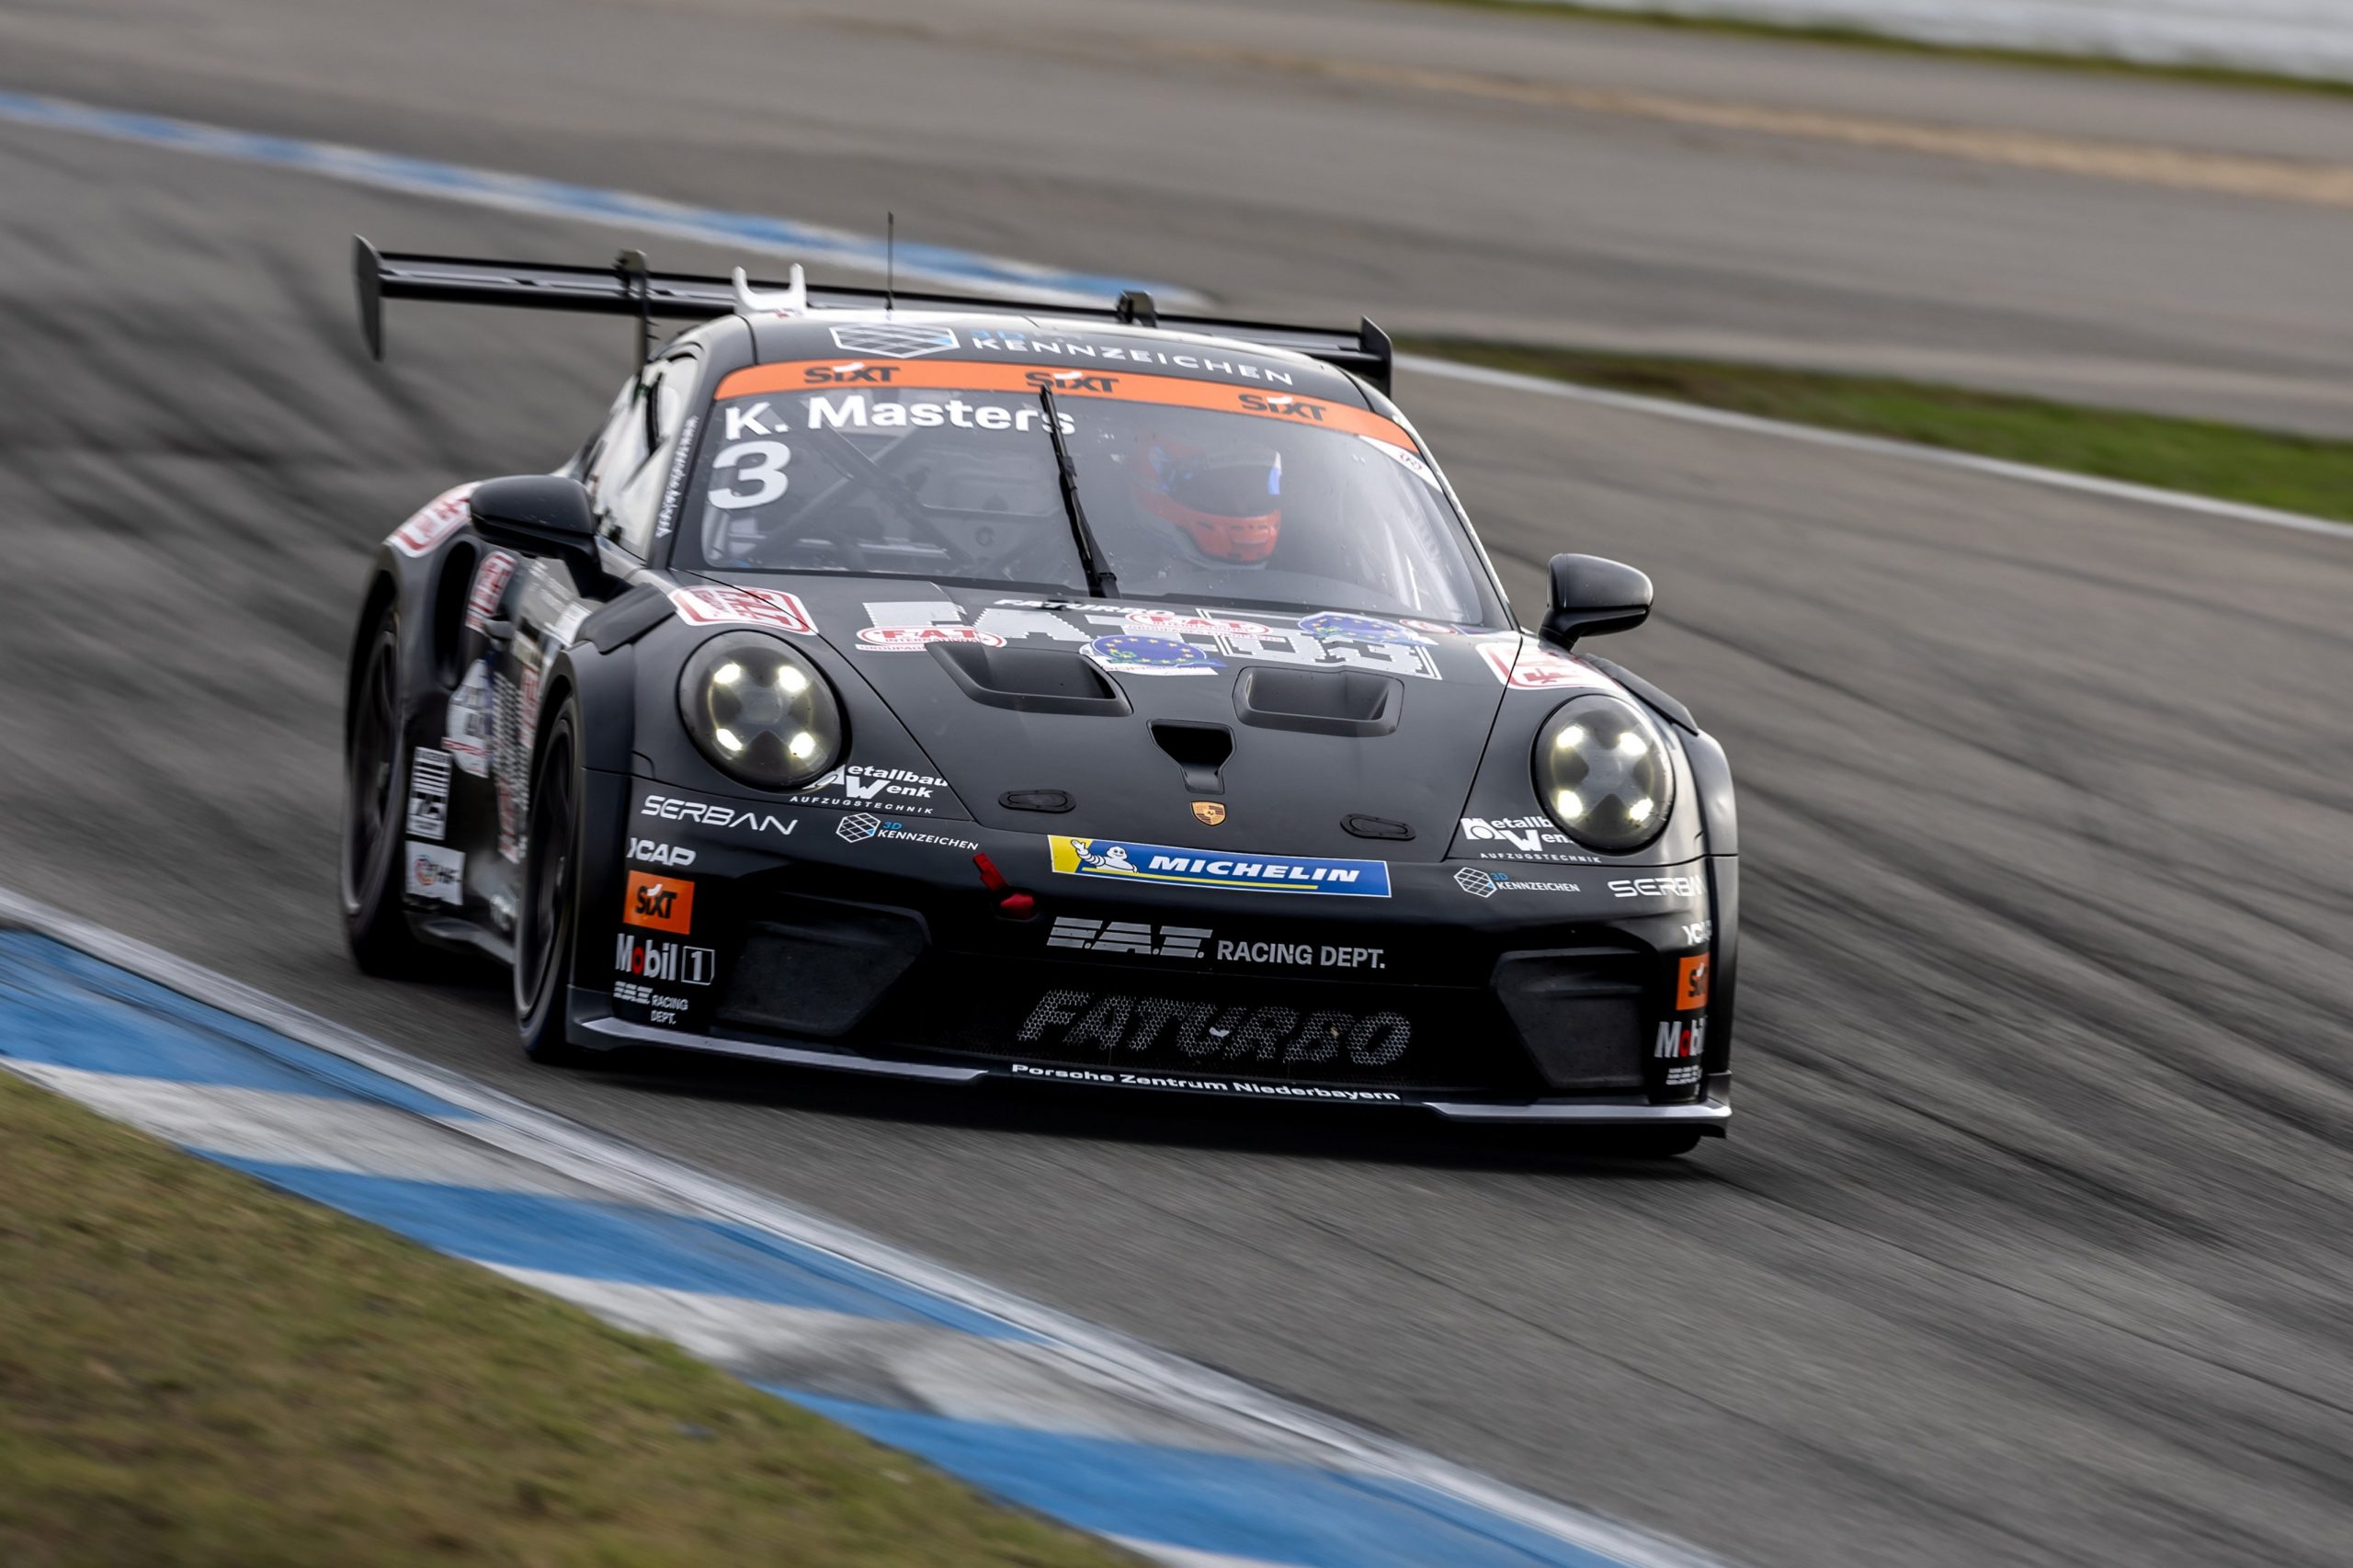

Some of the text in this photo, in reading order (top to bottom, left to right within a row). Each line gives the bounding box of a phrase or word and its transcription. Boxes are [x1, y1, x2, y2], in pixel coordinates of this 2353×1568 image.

[804, 362, 901, 383] SIXT
[972, 337, 1293, 386] KENNZEICHEN
[1025, 371, 1119, 393] SIXT
[725, 395, 1075, 440] K. Masters
[1238, 393, 1326, 421] SIXT
[708, 440, 791, 510] 3
[846, 776, 934, 799] Wenk
[641, 795, 798, 835] SERBAN
[790, 796, 934, 814] AUFZUGSTECHNIK
[882, 821, 902, 831] 3D
[878, 829, 979, 851] KENNZEICHEN
[1501, 830, 1575, 851] Wen
[1148, 855, 1359, 882] MICHELIN
[1480, 852, 1602, 864] AUFZUGSTECHNIK
[1491, 872, 1509, 881] 3D
[1496, 881, 1580, 892] KENNZEICHEN
[635, 883, 677, 919] SIXT
[616, 933, 677, 981] Mobil
[1217, 941, 1313, 966] RACING
[1320, 946, 1386, 970] DEPT.
[652, 994, 689, 1011] RACING
[651, 1010, 677, 1025] DEPT.
[1017, 990, 1412, 1067] FATURBO
[1012, 1063, 1401, 1102] Porsche Zentrum Niederbayern
